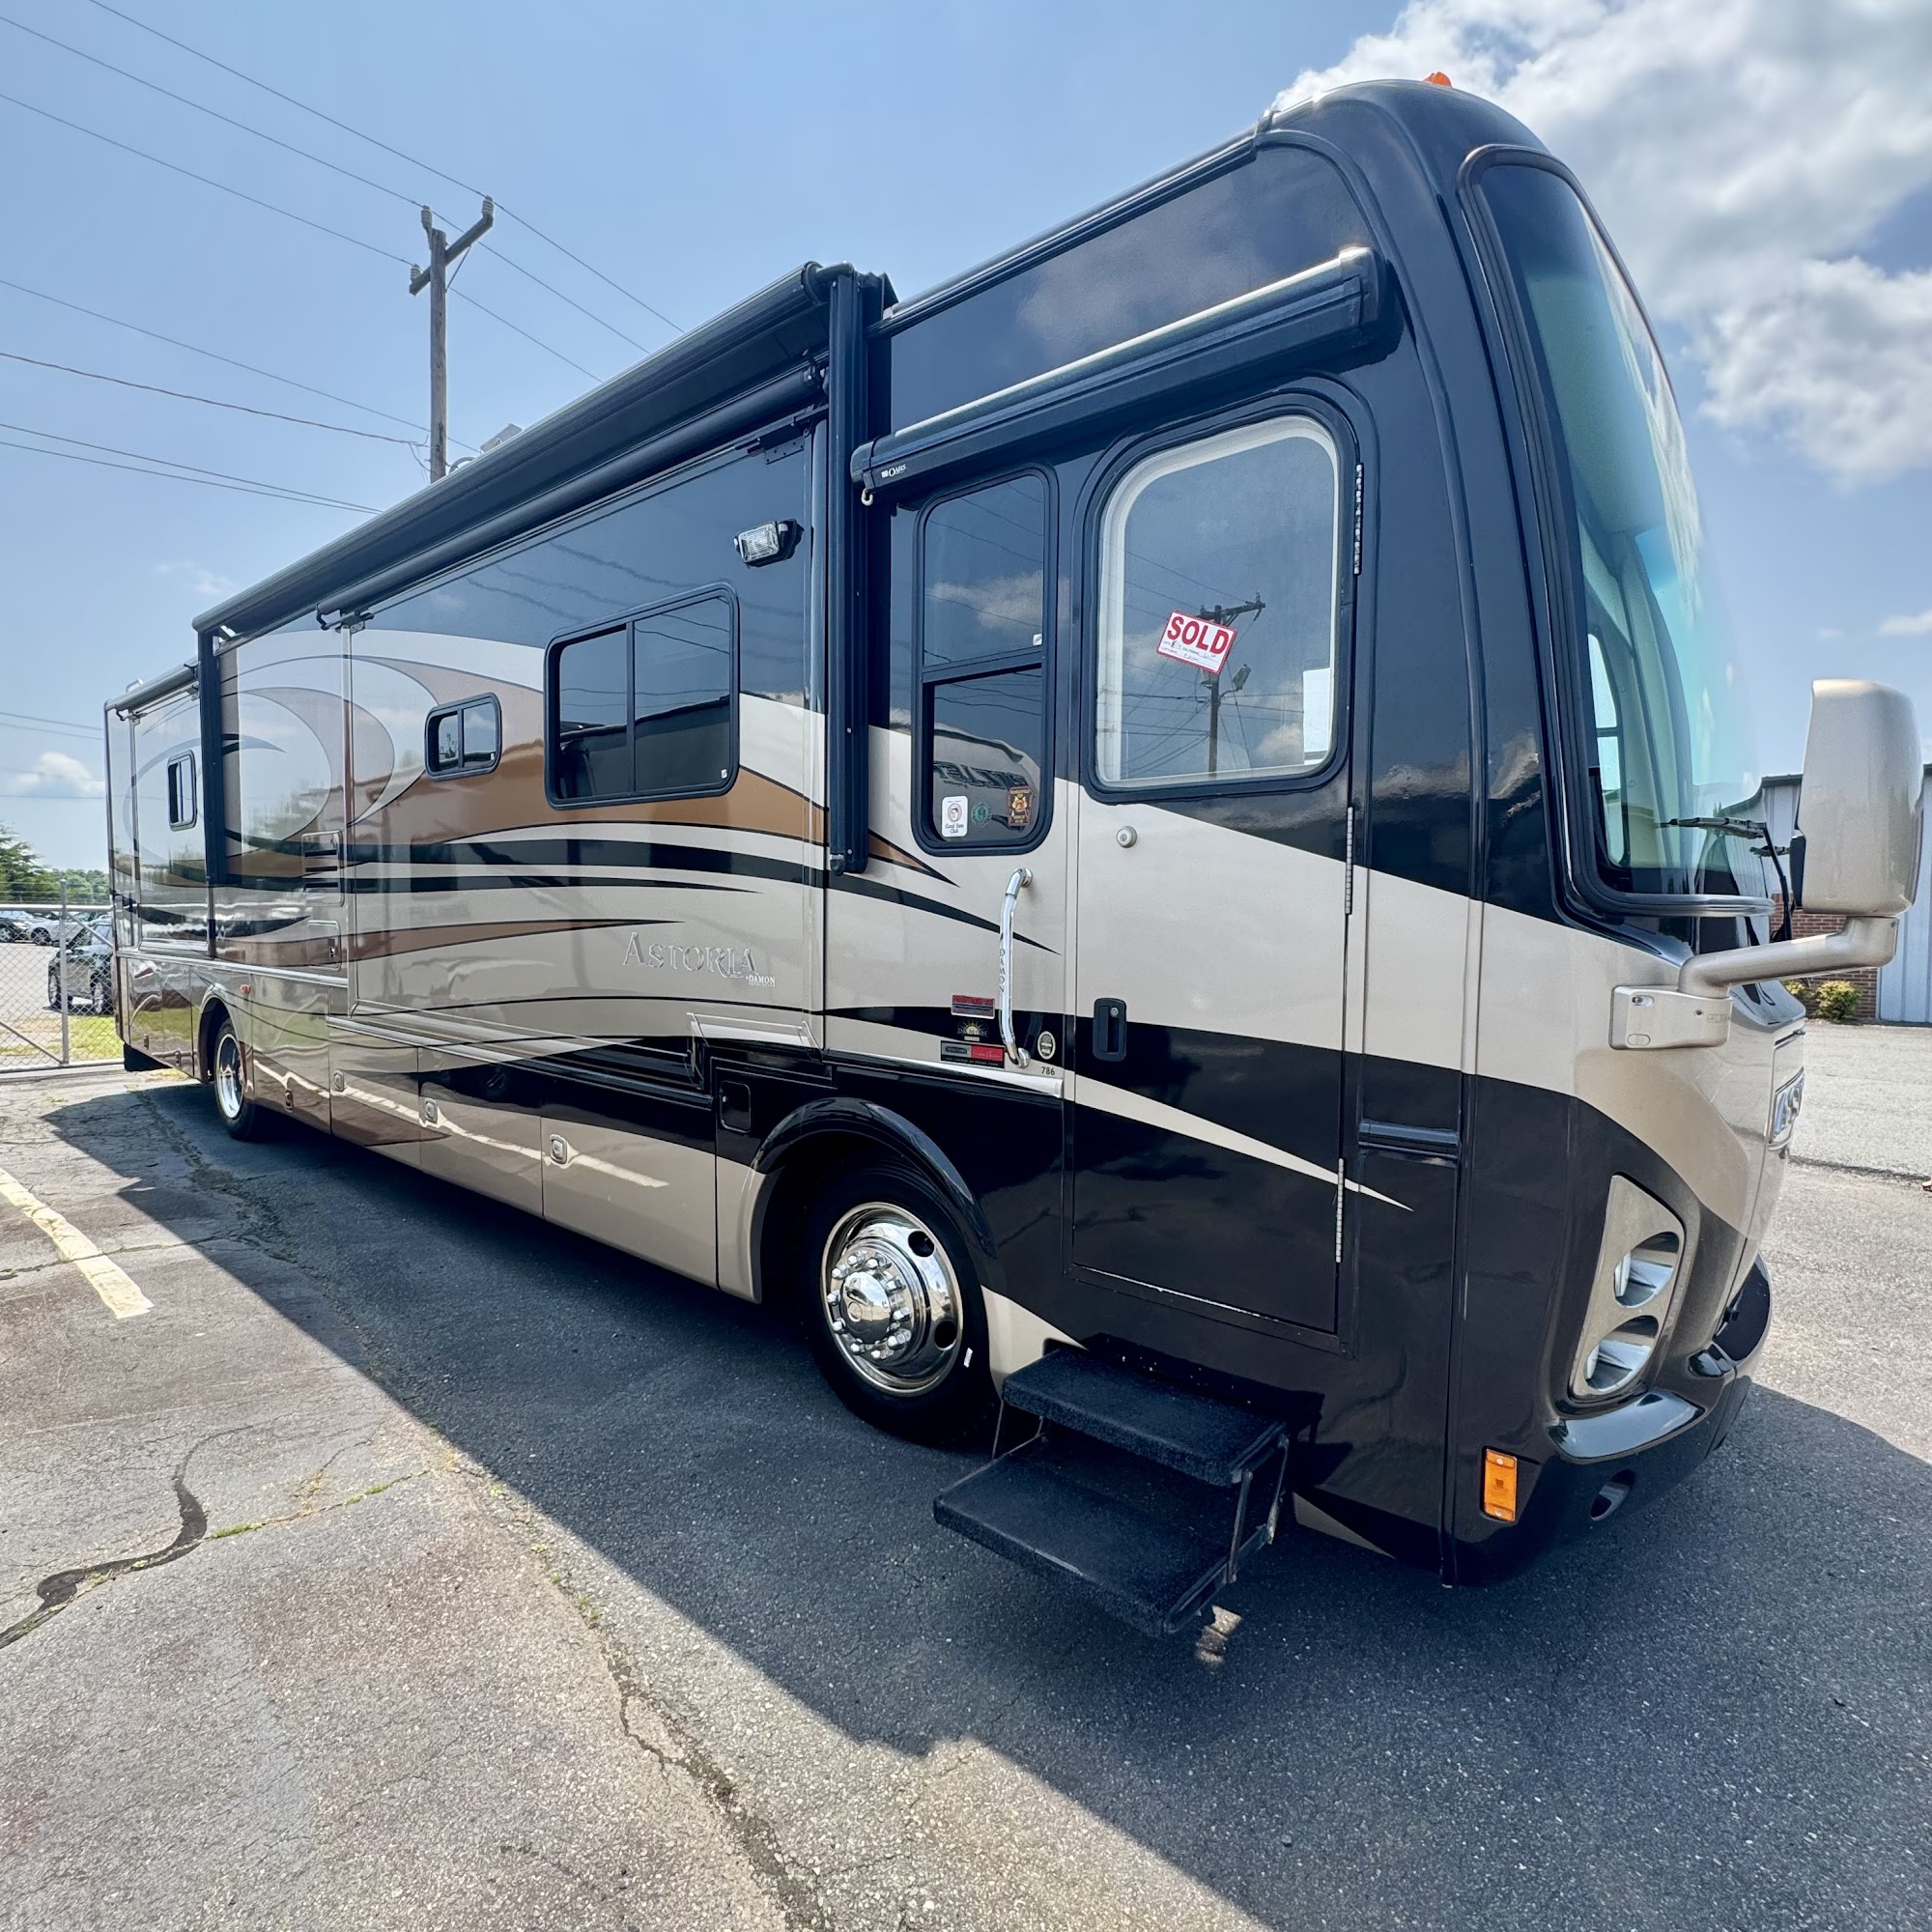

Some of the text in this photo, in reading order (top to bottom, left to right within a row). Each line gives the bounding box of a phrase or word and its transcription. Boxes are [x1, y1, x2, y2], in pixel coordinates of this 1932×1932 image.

[1167, 615, 1230, 654] SOLD
[748, 975, 776, 984] DAMON
[1040, 1065, 1056, 1076] 786
